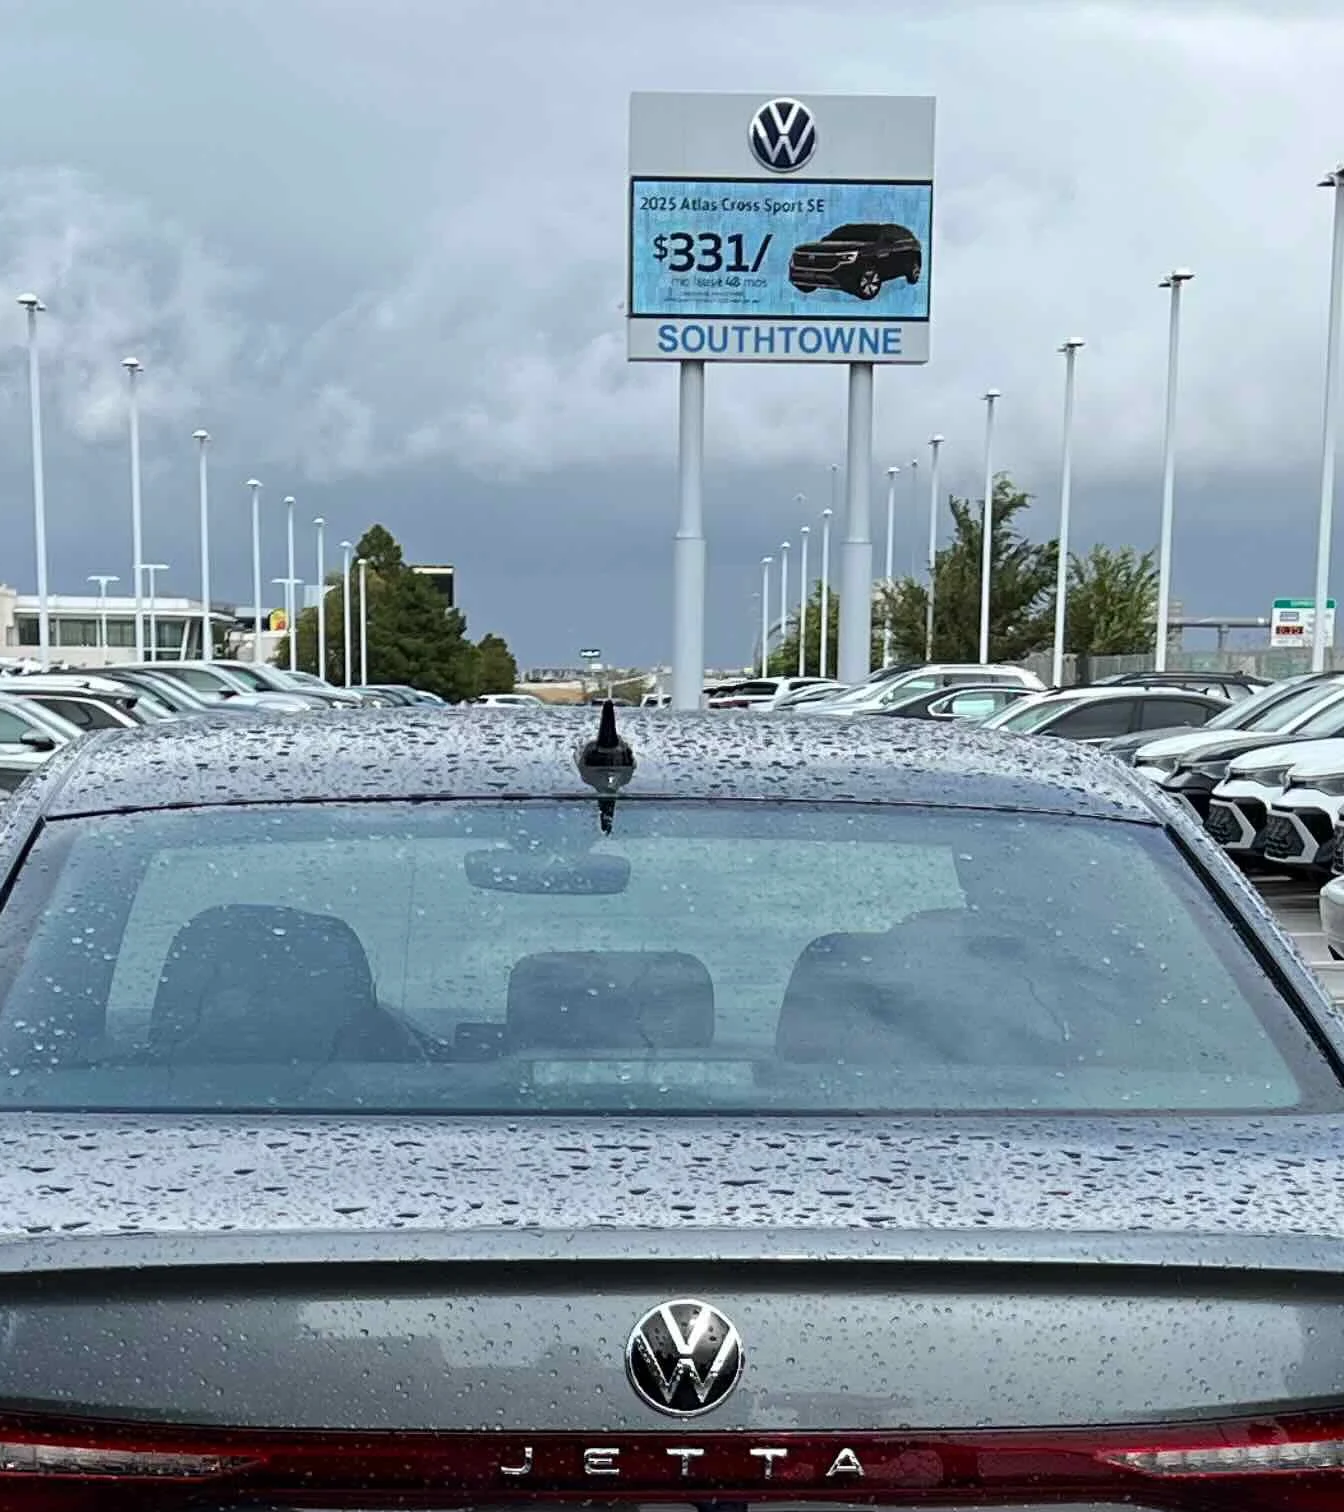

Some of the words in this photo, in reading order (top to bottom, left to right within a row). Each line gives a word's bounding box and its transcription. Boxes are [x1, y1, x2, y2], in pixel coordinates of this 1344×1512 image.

[640, 197, 676, 211] 2025
[680, 197, 718, 212] Atlas
[721, 198, 760, 212] Cross
[762, 198, 804, 215] Sport
[807, 199, 825, 213] SE
[657, 324, 903, 355] SOUTHTOWNE
[500, 1446, 866, 1480] JETTA
